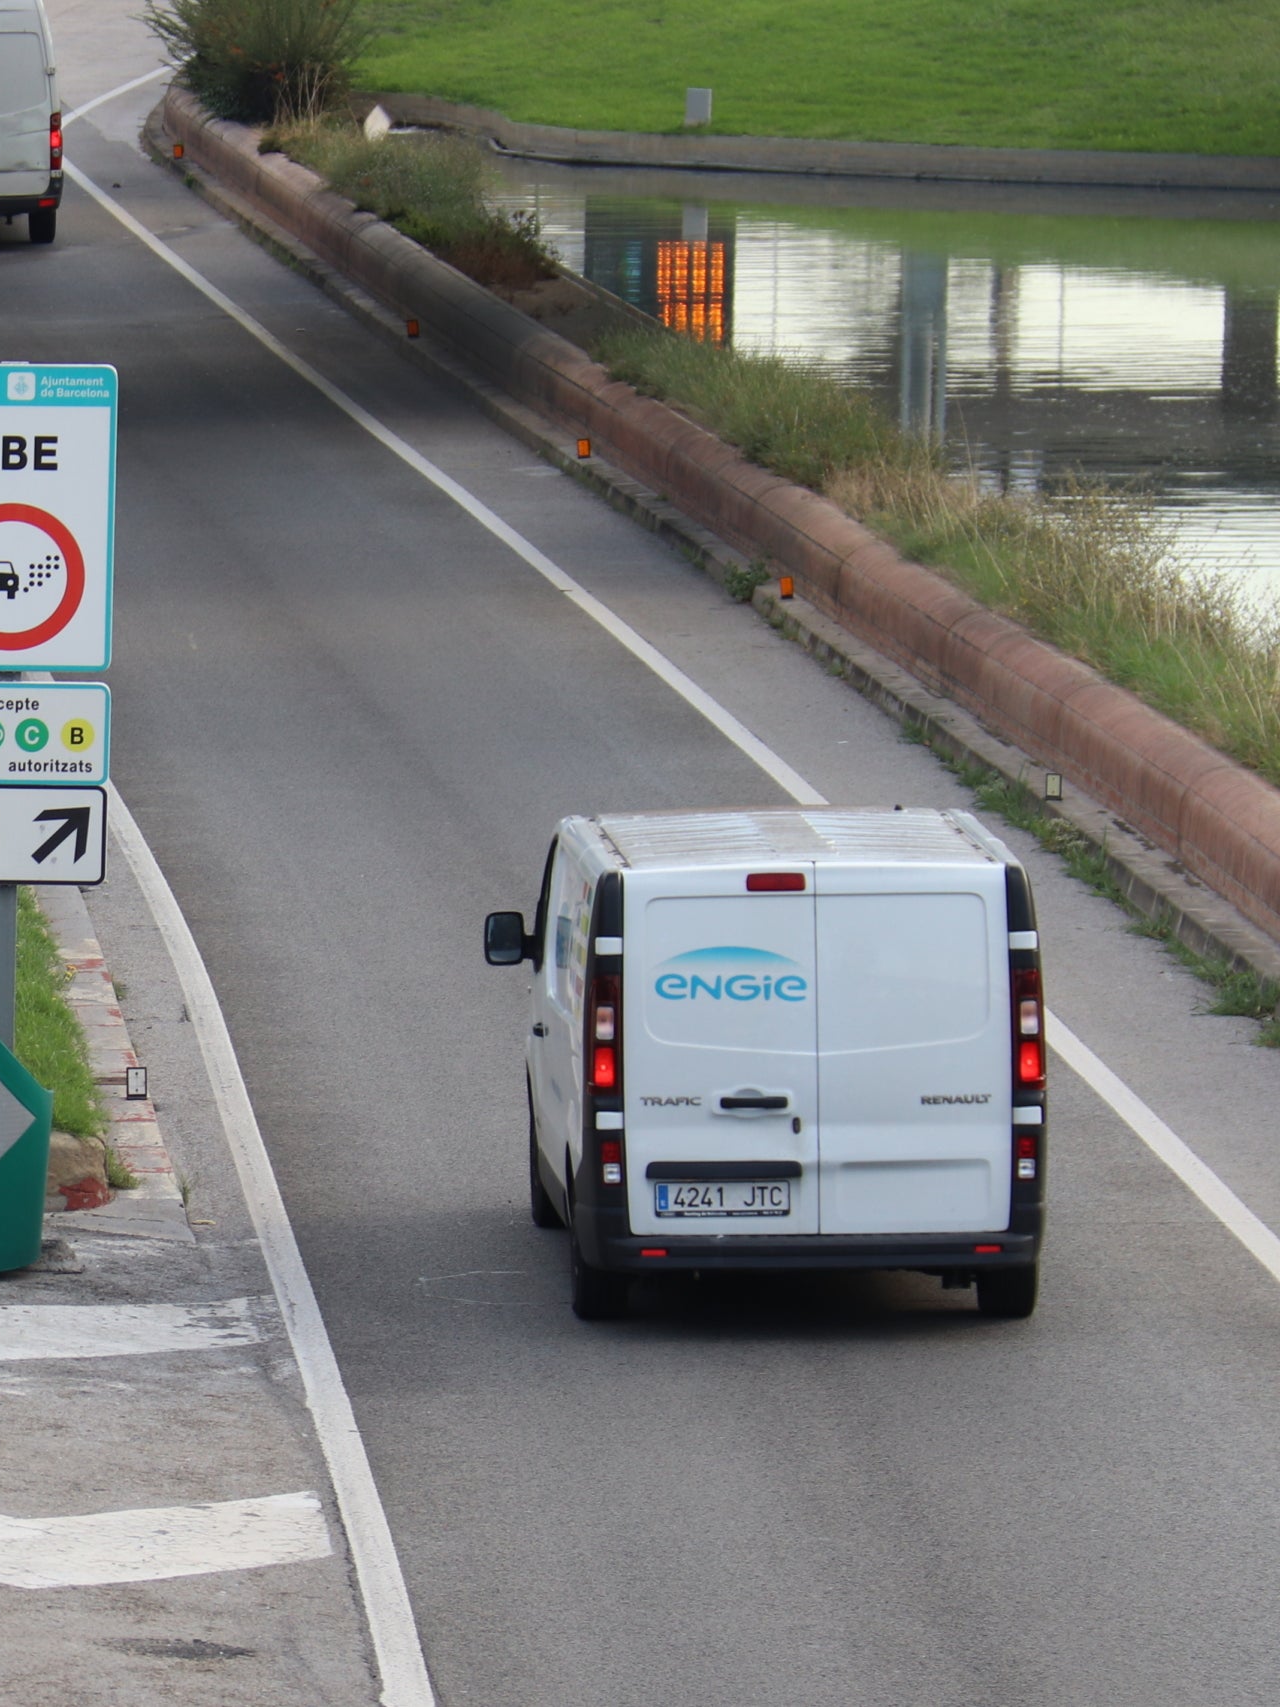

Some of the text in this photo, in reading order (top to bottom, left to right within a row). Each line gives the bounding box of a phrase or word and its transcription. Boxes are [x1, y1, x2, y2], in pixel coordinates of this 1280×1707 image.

[41, 377, 103, 387] Ajuntament
[41, 388, 110, 398] de Barcelona
[24, 726, 40, 743] C
[70, 727, 84, 745] B
[8, 759, 93, 773] autoritzats
[640, 1096, 702, 1107] TRAFIC
[920, 1094, 992, 1105] RENAULT
[673, 1186, 783, 1208] 4241 JTC
